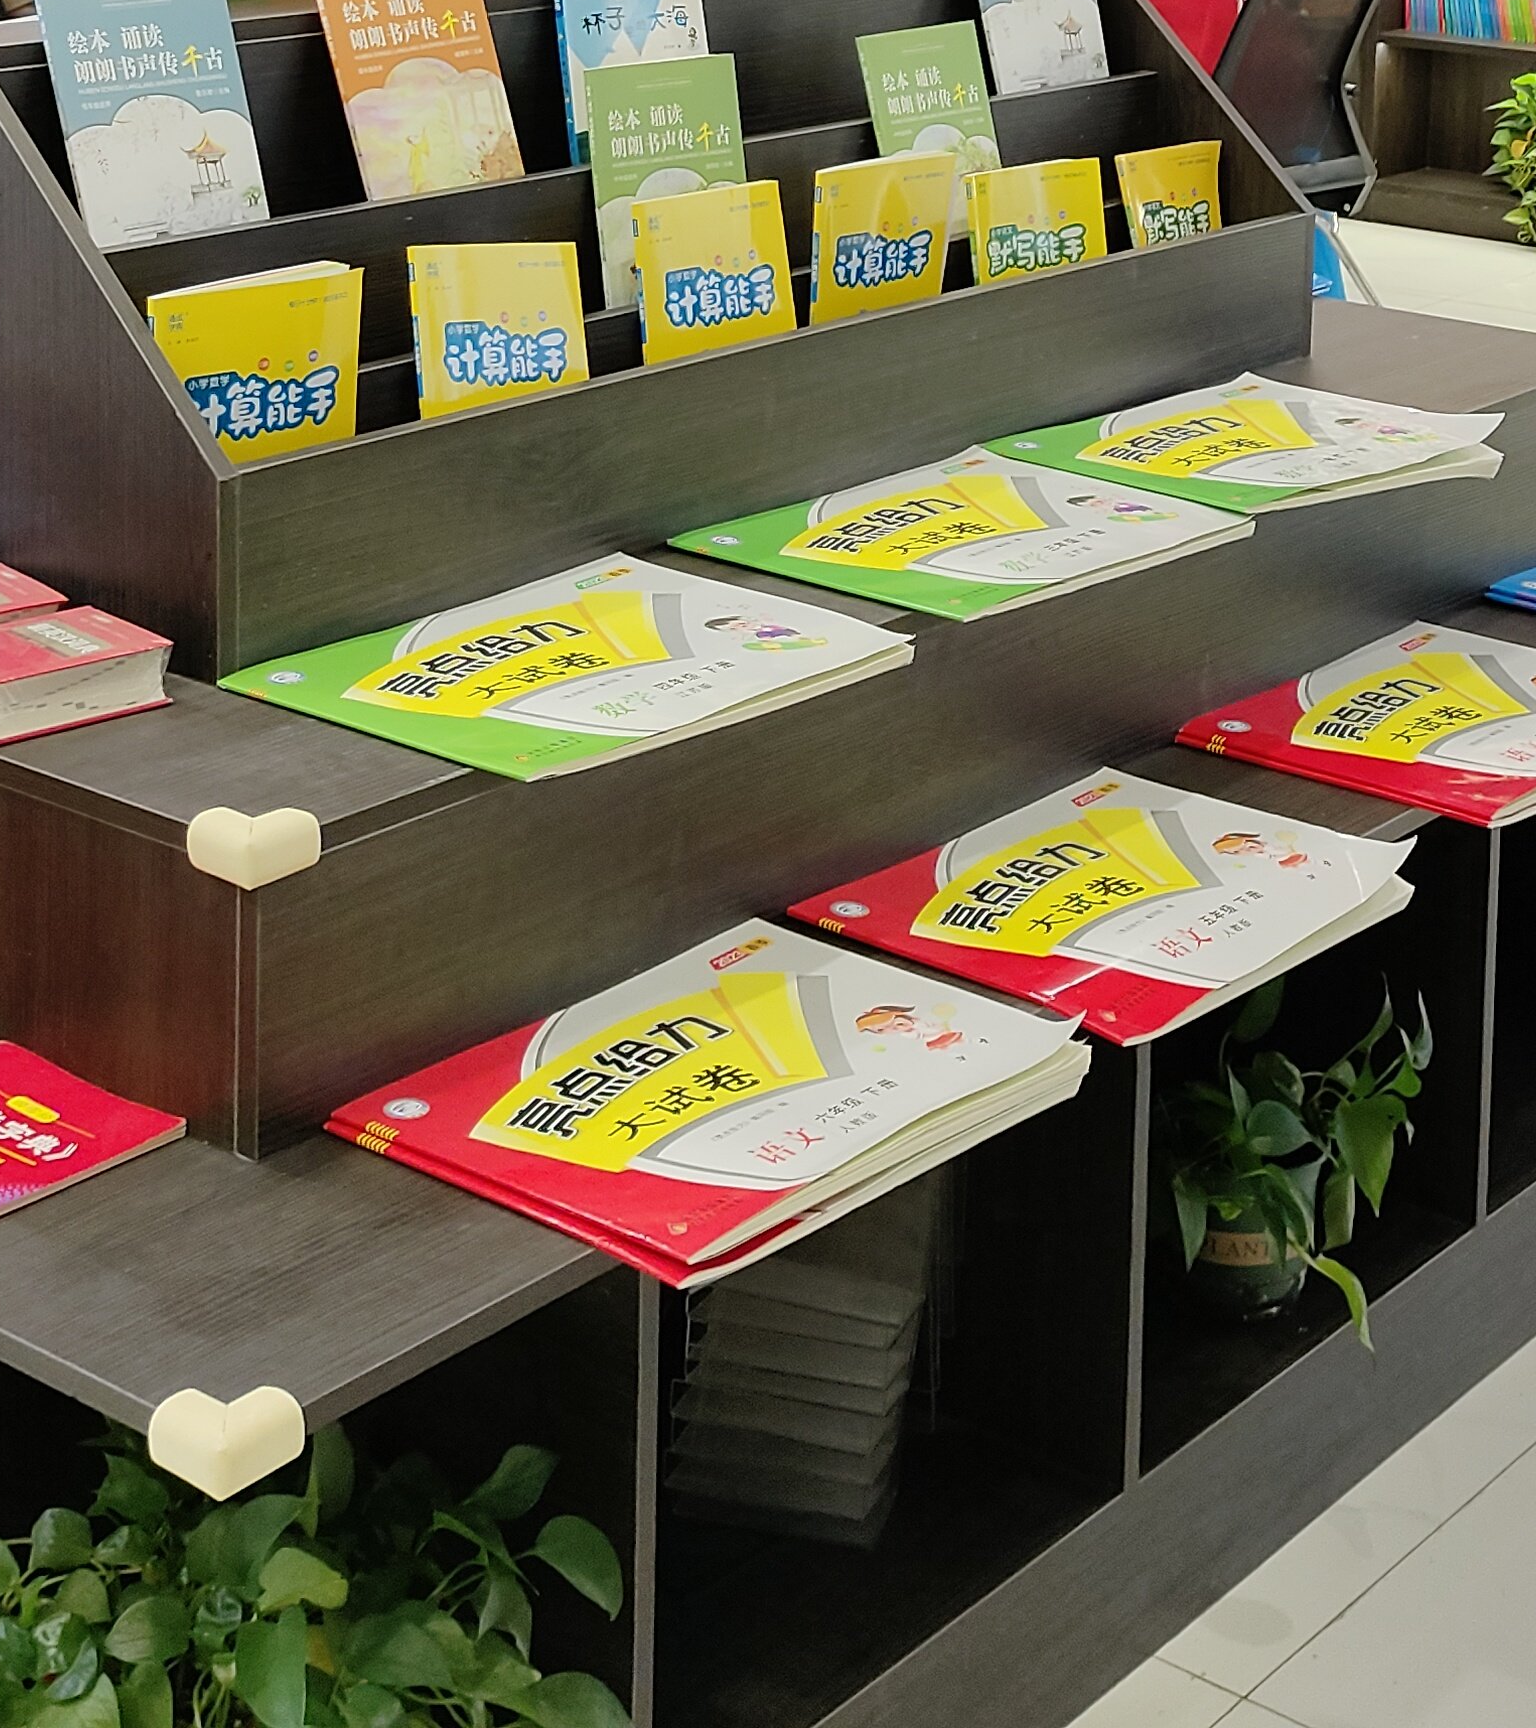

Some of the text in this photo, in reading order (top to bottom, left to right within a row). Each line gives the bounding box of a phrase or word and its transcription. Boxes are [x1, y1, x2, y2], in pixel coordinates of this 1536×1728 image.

[67, 23, 164, 55] 绘本 诵读
[348, 9, 477, 51] 朗朗书声传千古
[73, 43, 224, 84] 朗朗书声传千古
[880, 65, 943, 92] 绘本 诵读
[607, 102, 684, 132] 绘本 诵读
[886, 81, 980, 117] 朗朗书声传千古
[611, 121, 731, 160] 朗朗书声传千古
[835, 230, 931, 285] 计算能手
[988, 224, 1085, 275] 默写能手
[665, 266, 775, 325] 计算能手
[446, 329, 565, 382] 计算能手
[187, 374, 231, 392] 小学数学
[1098, 415, 1247, 466] 亮点给力
[1178, 436, 1272, 469] 大试卷
[807, 496, 969, 557] 亮点给力
[884, 521, 998, 559] 大试卷
[377, 617, 591, 702] 亮点给力
[467, 651, 611, 702] 大试卷
[592, 690, 657, 719] 数学
[652, 672, 702, 691] 四年级
[1312, 676, 1445, 744] 亮点给力
[1388, 705, 1483, 745] 大试卷
[937, 839, 1110, 935] 亮点给力
[1026, 875, 1146, 935] 大试卷
[1151, 890, 1265, 959] 语文 五年级 下册
[505, 1013, 735, 1141] 亮点给力
[607, 1063, 763, 1145] 大试卷
[748, 1077, 900, 1165] 语文 六年级 下册
[838, 1111, 880, 1135] 人教版
